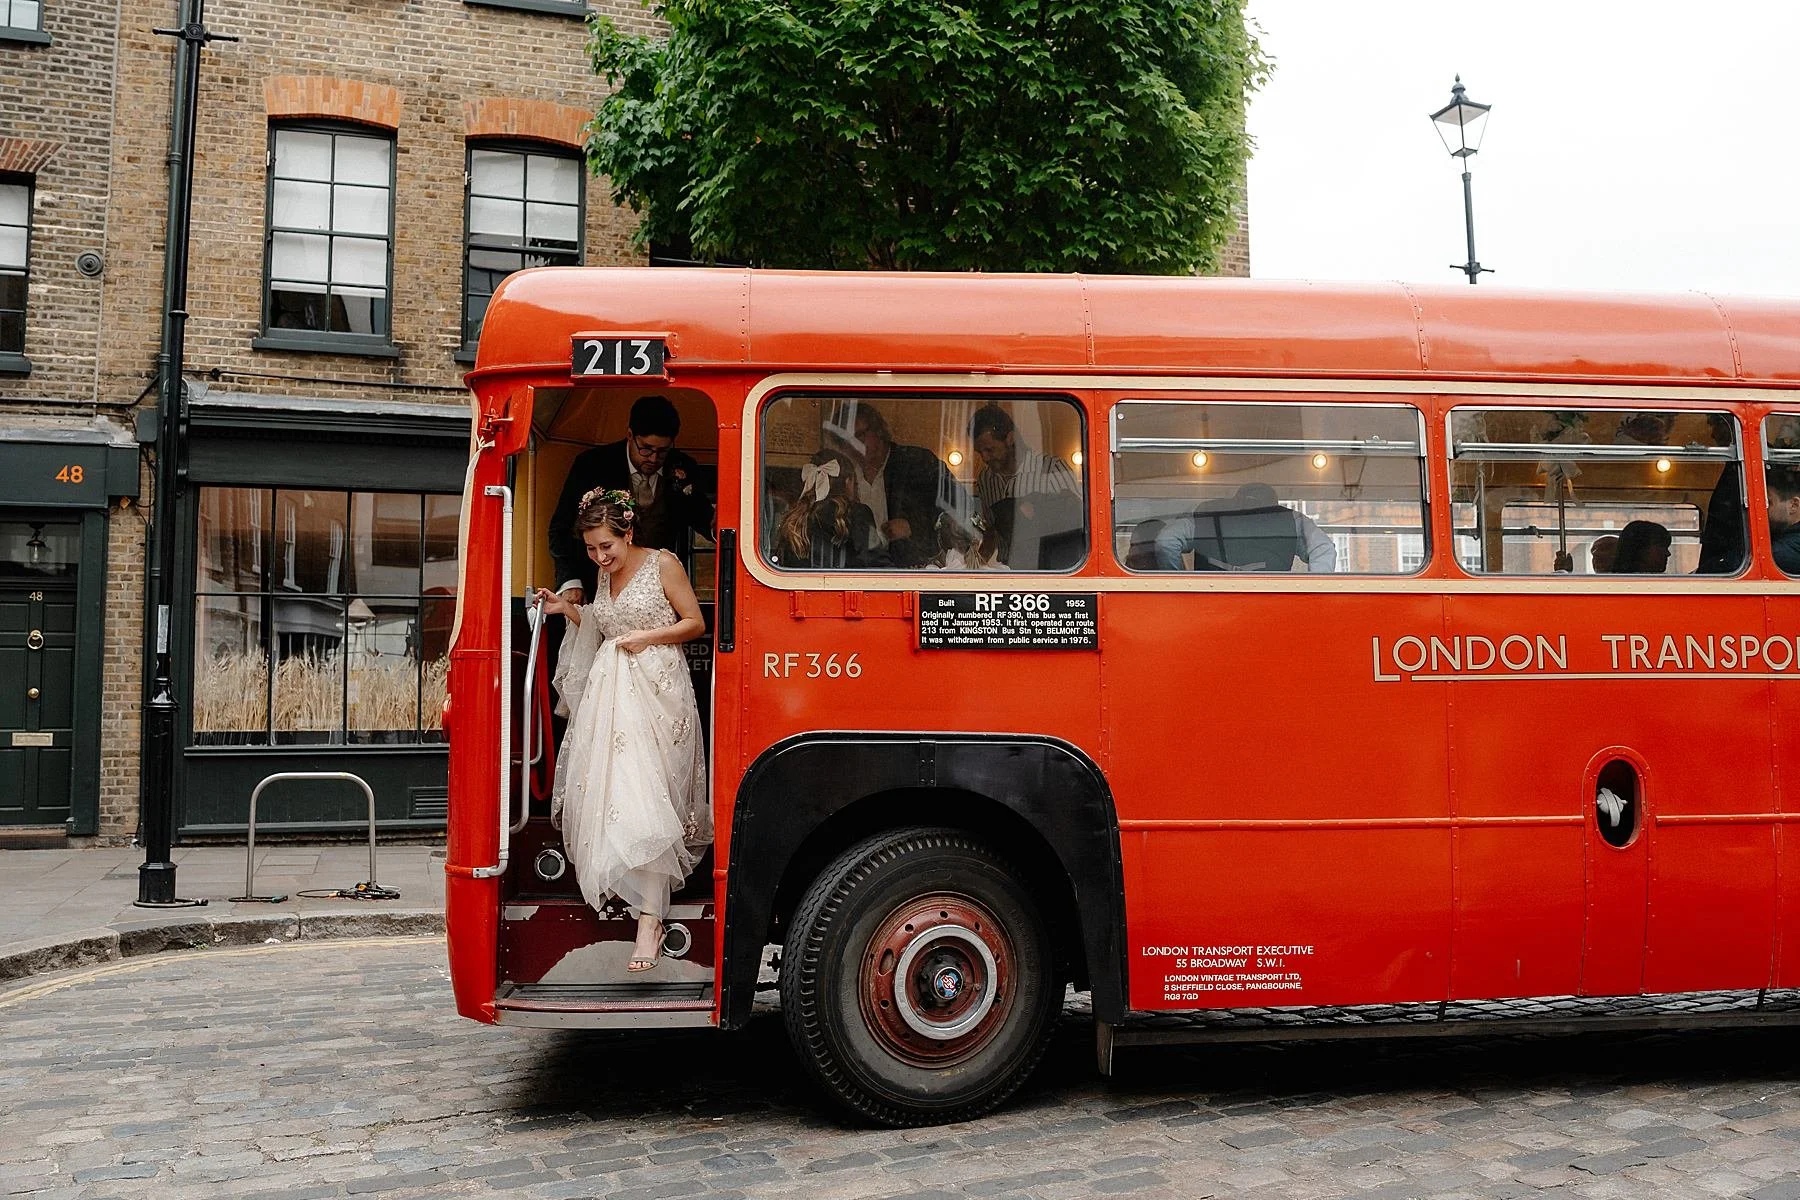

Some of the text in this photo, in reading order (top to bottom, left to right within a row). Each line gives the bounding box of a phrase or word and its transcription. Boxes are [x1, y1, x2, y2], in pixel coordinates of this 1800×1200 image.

[583, 339, 651, 375] 213
[55, 464, 84, 483] 48
[29, 591, 43, 601] 48
[938, 593, 1086, 612] Built RF 366 1952
[921, 611, 955, 620] Originally
[957, 611, 993, 619] numbered
[1026, 611, 1040, 619] this
[921, 619, 939, 627] used
[951, 619, 980, 627] January
[981, 619, 1004, 627] 1953.
[1013, 619, 1028, 627] first
[1030, 620, 1063, 628] operated
[1075, 619, 1095, 627] route
[921, 626, 937, 634] 213
[938, 626, 956, 634] from
[959, 627, 998, 635] KINGSTON
[1001, 627, 1016, 635] Bus
[1018, 627, 1032, 635] Stn
[1034, 627, 1043, 635] to
[1046, 627, 1081, 635] BELMONT
[921, 636, 928, 644] It
[947, 636, 984, 644] withdrawn
[987, 636, 1005, 644] from
[1008, 636, 1030, 645] public
[1032, 636, 1059, 644] service
[1061, 636, 1068, 644] in
[1068, 636, 1092, 644] 1976.
[1372, 634, 1568, 681] LONDON
[1142, 945, 1315, 956] LONDON TRANSPORT EXECUTIVE
[1175, 958, 1188, 968] 55
[1190, 958, 1248, 968] BROADWAY
[1164, 975, 1199, 983] LONDON
[1200, 974, 1235, 982] VINTAGE
[1236, 973, 1284, 981] TRANSPORT
[1164, 982, 1303, 992] 8 SHEFFIELD CLOSE, PANGBOURNE,
[1164, 993, 1181, 1001] RG8
